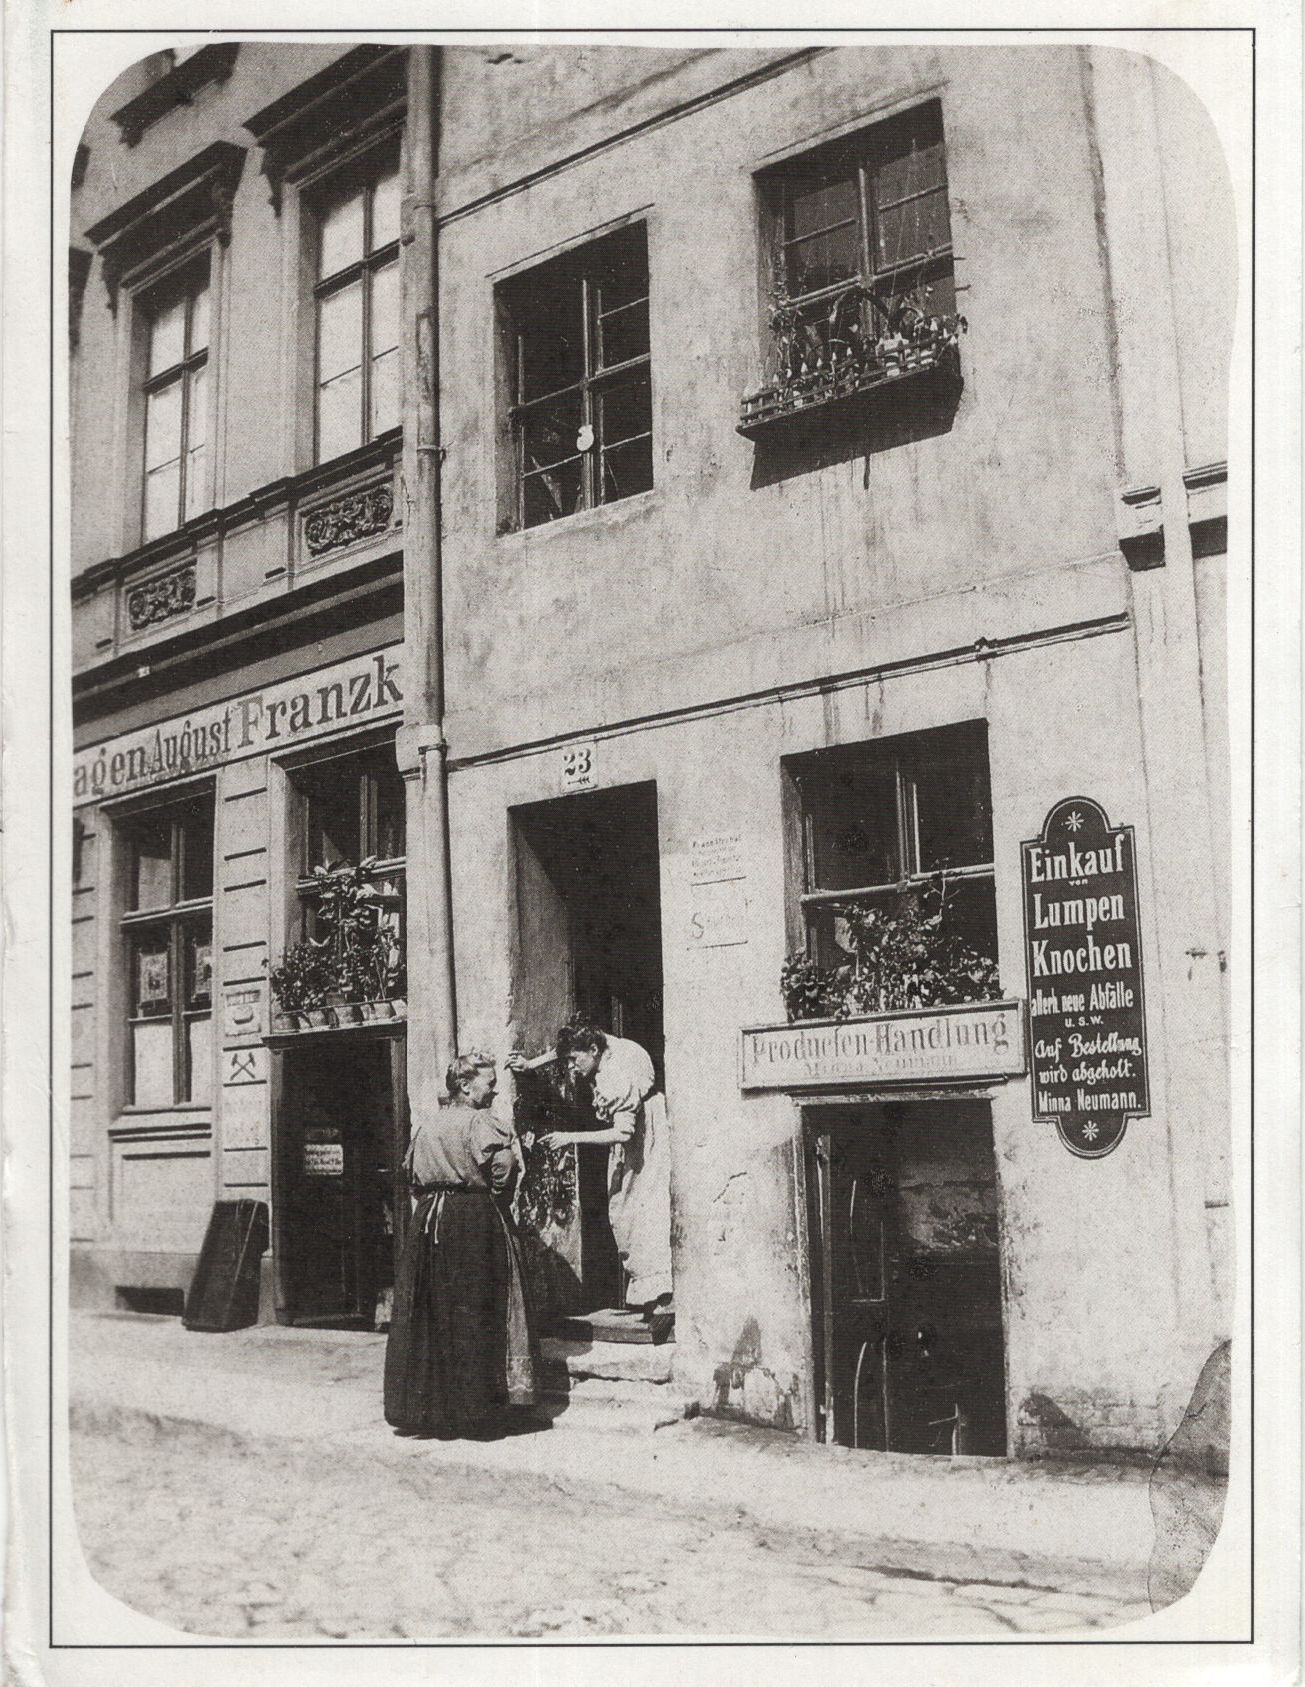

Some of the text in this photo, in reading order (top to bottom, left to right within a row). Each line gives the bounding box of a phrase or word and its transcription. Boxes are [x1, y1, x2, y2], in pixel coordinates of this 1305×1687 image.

[151, 706, 232, 773] August
[234, 655, 404, 749] Franzk
[564, 749, 591, 776] 23
[1029, 834, 1124, 882] Einkauf
[1033, 893, 1125, 931] Lumpen
[1032, 935, 1132, 977] Knochen
[1062, 993, 1085, 1013] neue
[1090, 981, 1133, 1011] Abfälle
[1035, 1031, 1142, 1063] Auf Bestellung
[1039, 1059, 1136, 1085] wird abgeholt.
[1038, 1088, 1142, 1113] Minna Neumann.
